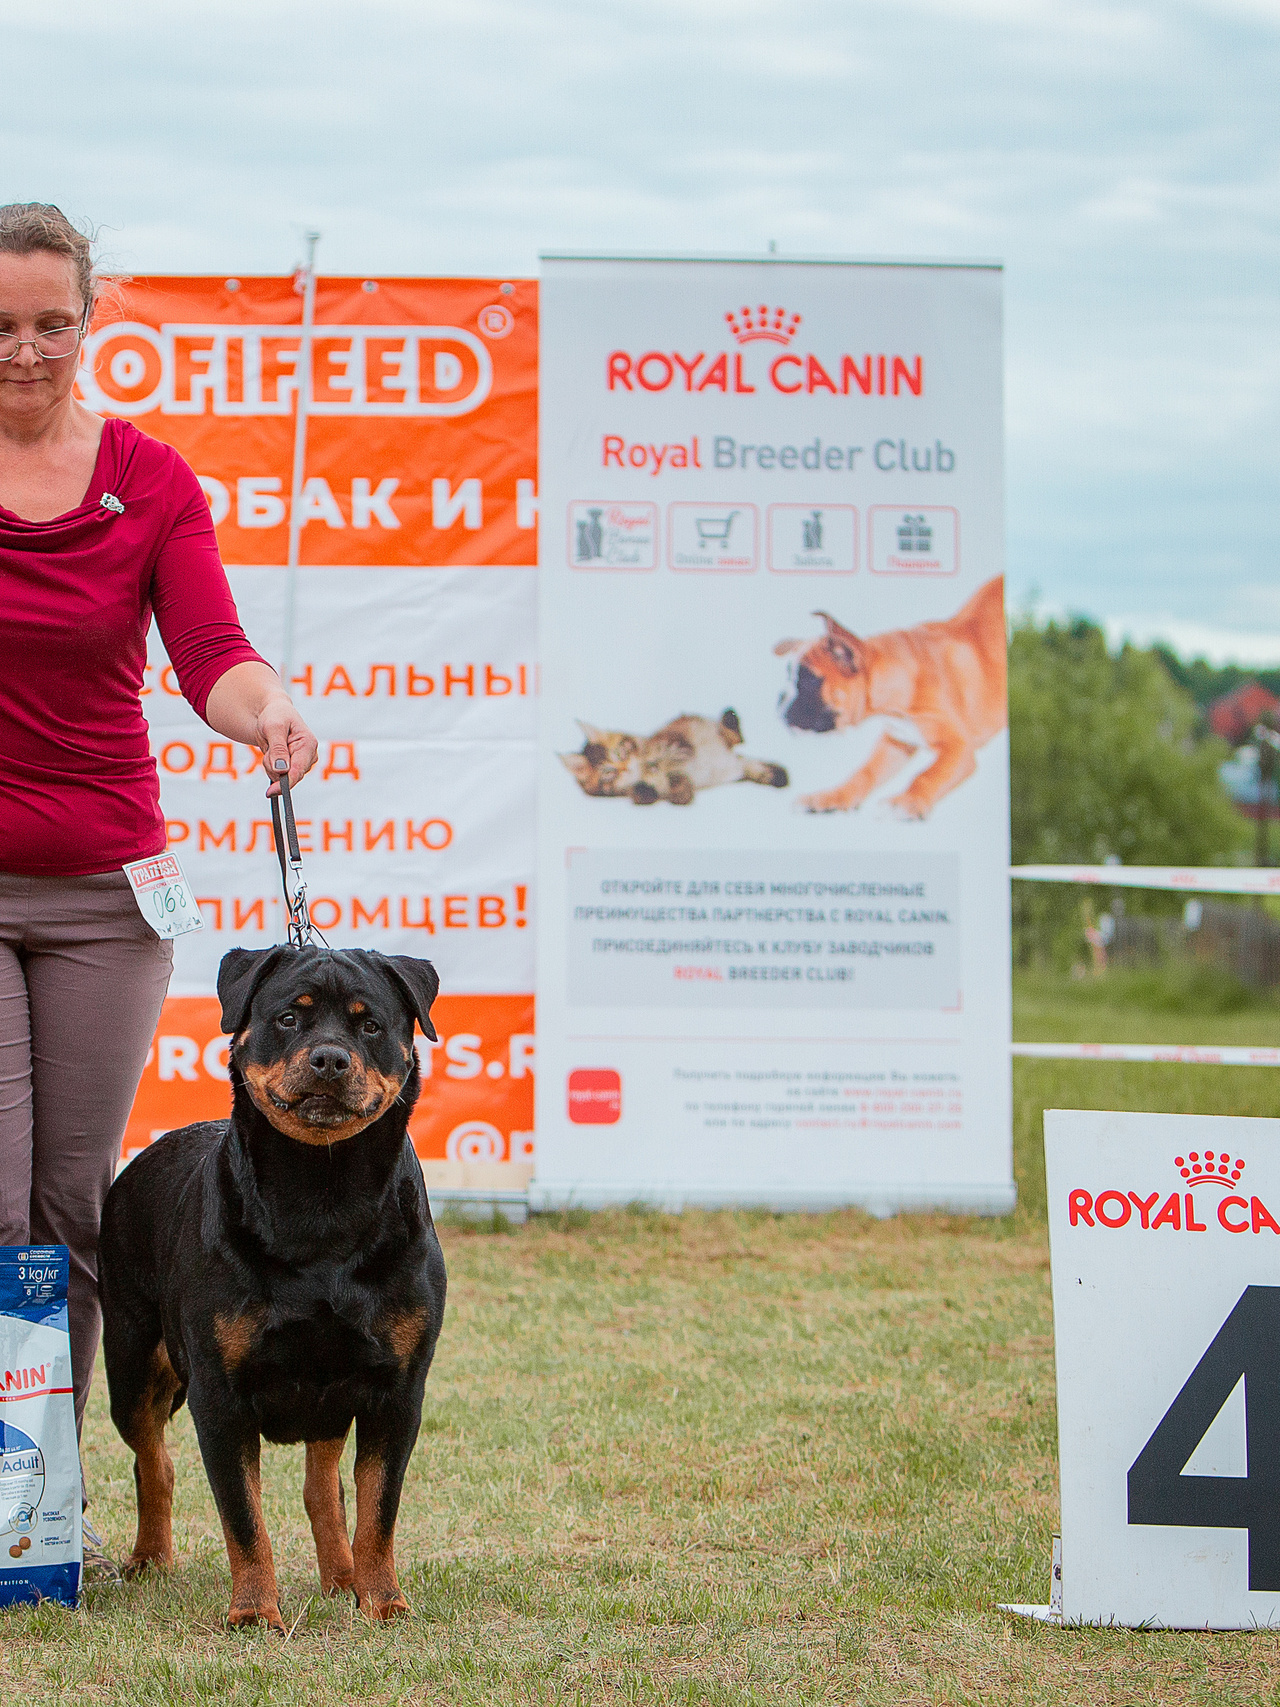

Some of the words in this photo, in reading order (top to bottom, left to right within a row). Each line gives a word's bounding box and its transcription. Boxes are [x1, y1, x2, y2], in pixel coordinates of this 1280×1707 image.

[78, 324, 490, 415] OFIFEED
[607, 350, 756, 393] ROYAL
[769, 354, 923, 396] CANIN
[602, 434, 702, 476] Royal
[713, 436, 862, 470] Breeder
[873, 439, 956, 473] Club
[431, 478, 483, 530] И
[152, 884, 187, 919] 068
[196, 884, 528, 934] ПИОМЦЕВ!
[1068, 1188, 1207, 1231] ROYAL
[18, 1266, 26, 1280] 3
[28, 1266, 59, 1283] kg/кг
[1127, 1284, 1280, 1592] 4
[2, 1456, 39, 1473] Adult
